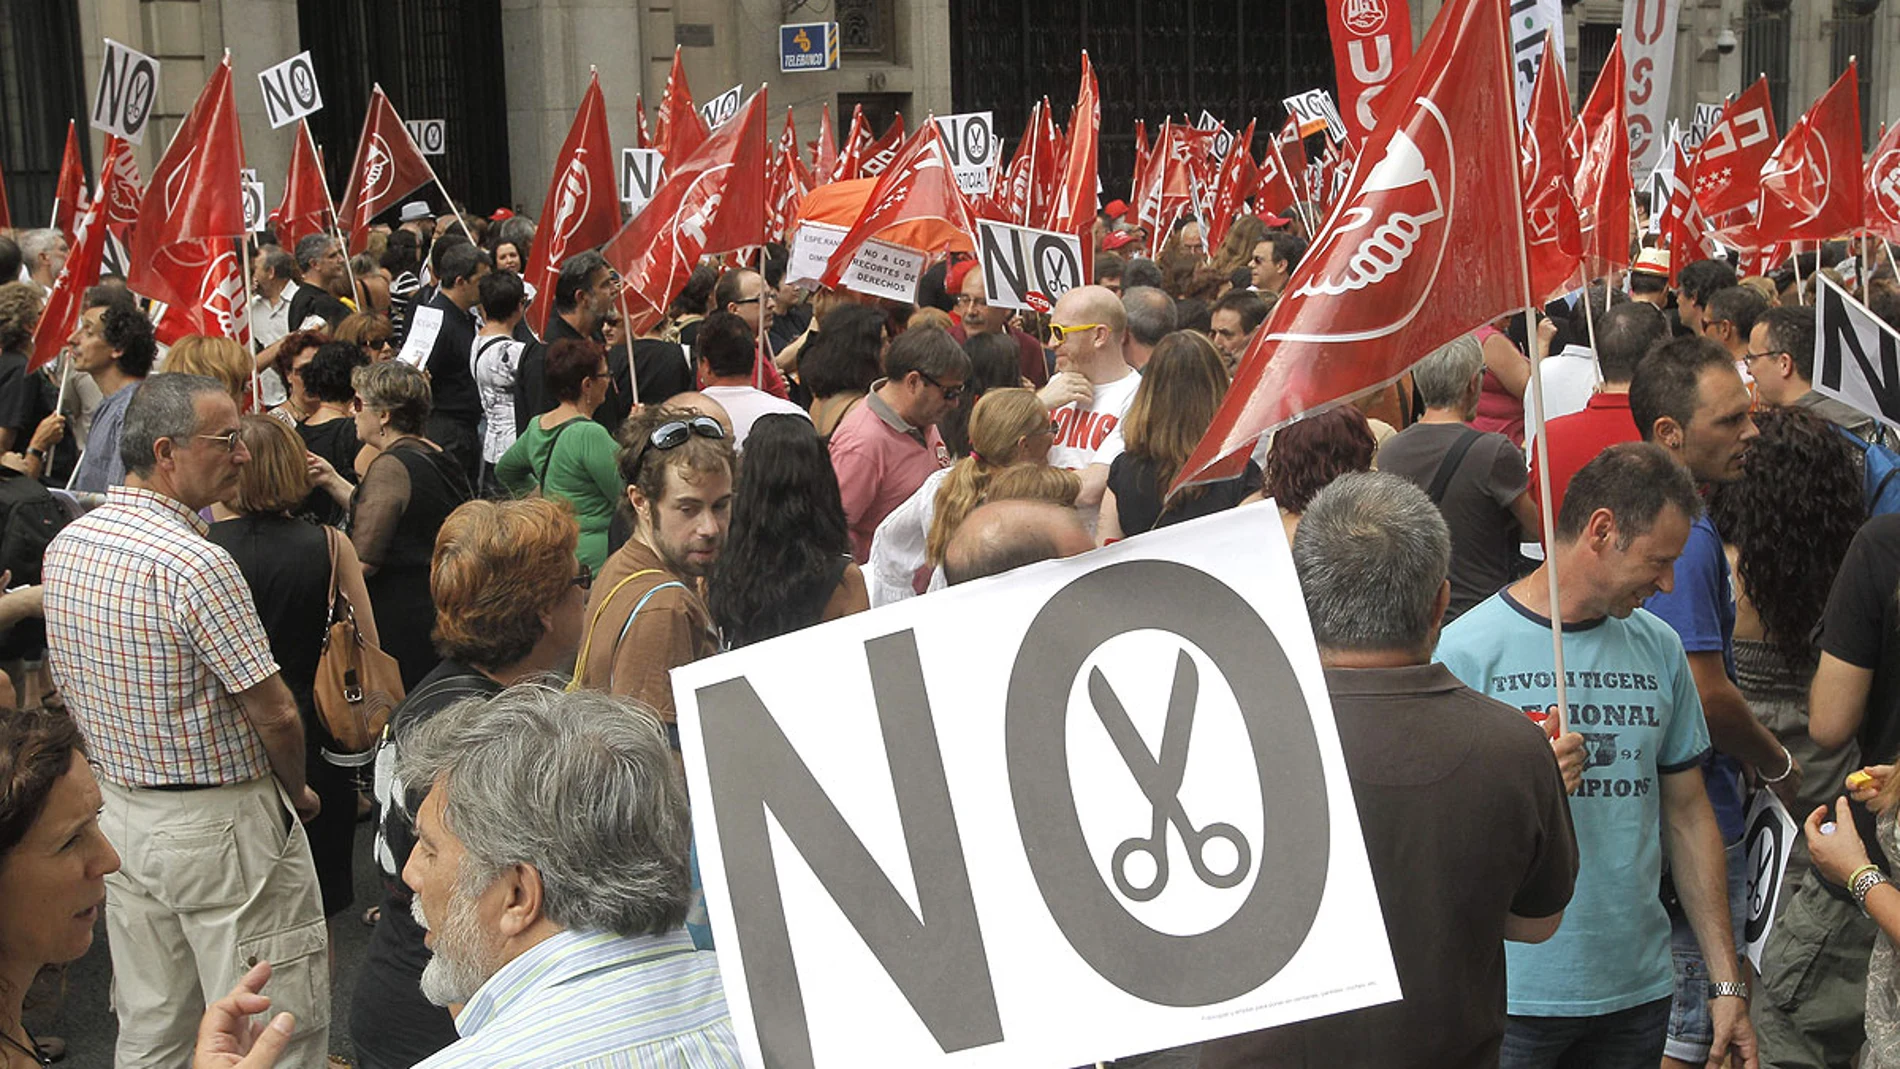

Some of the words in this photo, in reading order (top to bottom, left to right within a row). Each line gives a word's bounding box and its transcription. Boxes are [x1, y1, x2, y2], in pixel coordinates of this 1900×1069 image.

[784, 53, 824, 67] TELEBANCO
[95, 45, 155, 135] NO
[261, 58, 316, 123] NO
[937, 116, 990, 166] NO
[624, 152, 664, 199] N
[853, 258, 900, 278] RECORTES
[904, 271, 917, 283] DE
[857, 272, 906, 292] DERECHOS
[864, 249, 878, 259] NO
[882, 254, 889, 263] A
[893, 257, 912, 268] LOS
[980, 224, 1080, 308] NO
[1579, 672, 1658, 690] TIGERS
[695, 558, 1331, 1069] NO
